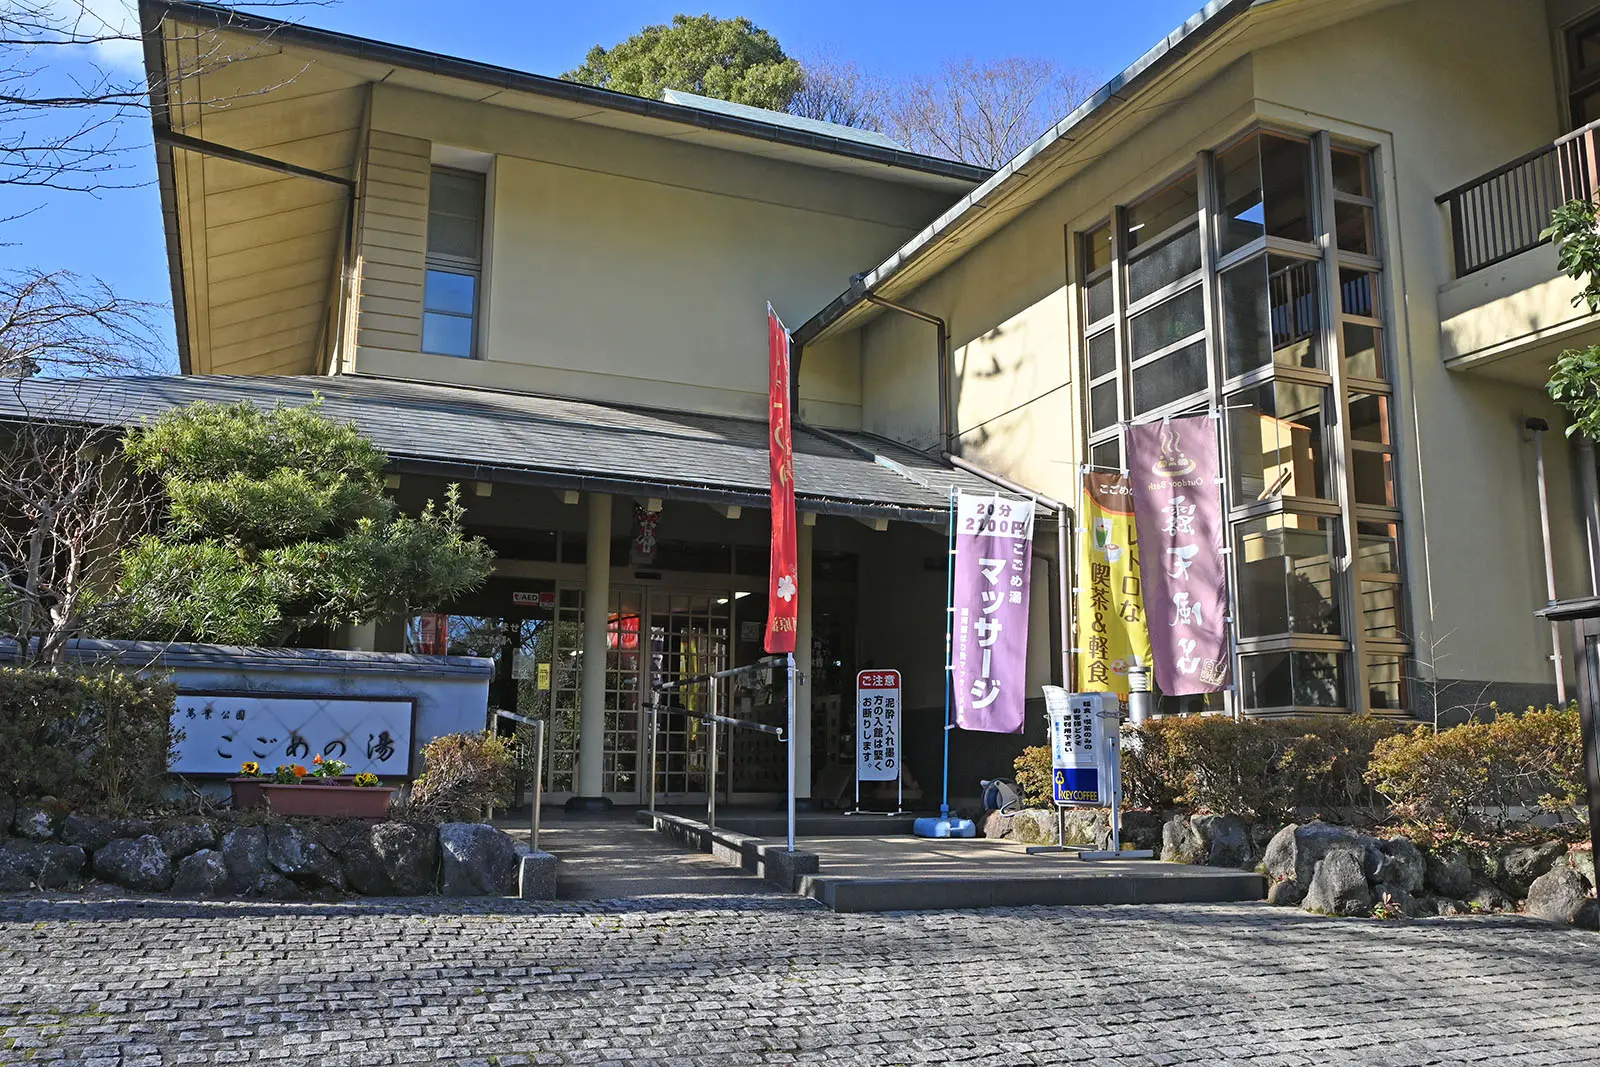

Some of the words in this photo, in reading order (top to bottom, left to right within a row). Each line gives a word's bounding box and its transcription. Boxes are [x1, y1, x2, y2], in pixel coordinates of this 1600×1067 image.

[976, 503, 1012, 518] 20分
[521, 594, 538, 602] AED
[1118, 524, 1141, 624] レトロな
[970, 558, 1007, 710] マッサージ
[1087, 562, 1111, 686] 喫茶&軽食
[862, 674, 896, 687] ご注意
[217, 730, 396, 763] こごめの湯
[862, 697, 872, 768] お断りします。
[873, 695, 884, 771] 方の入館は堅く
[884, 697, 895, 769] 泥酔・入れ墨の
